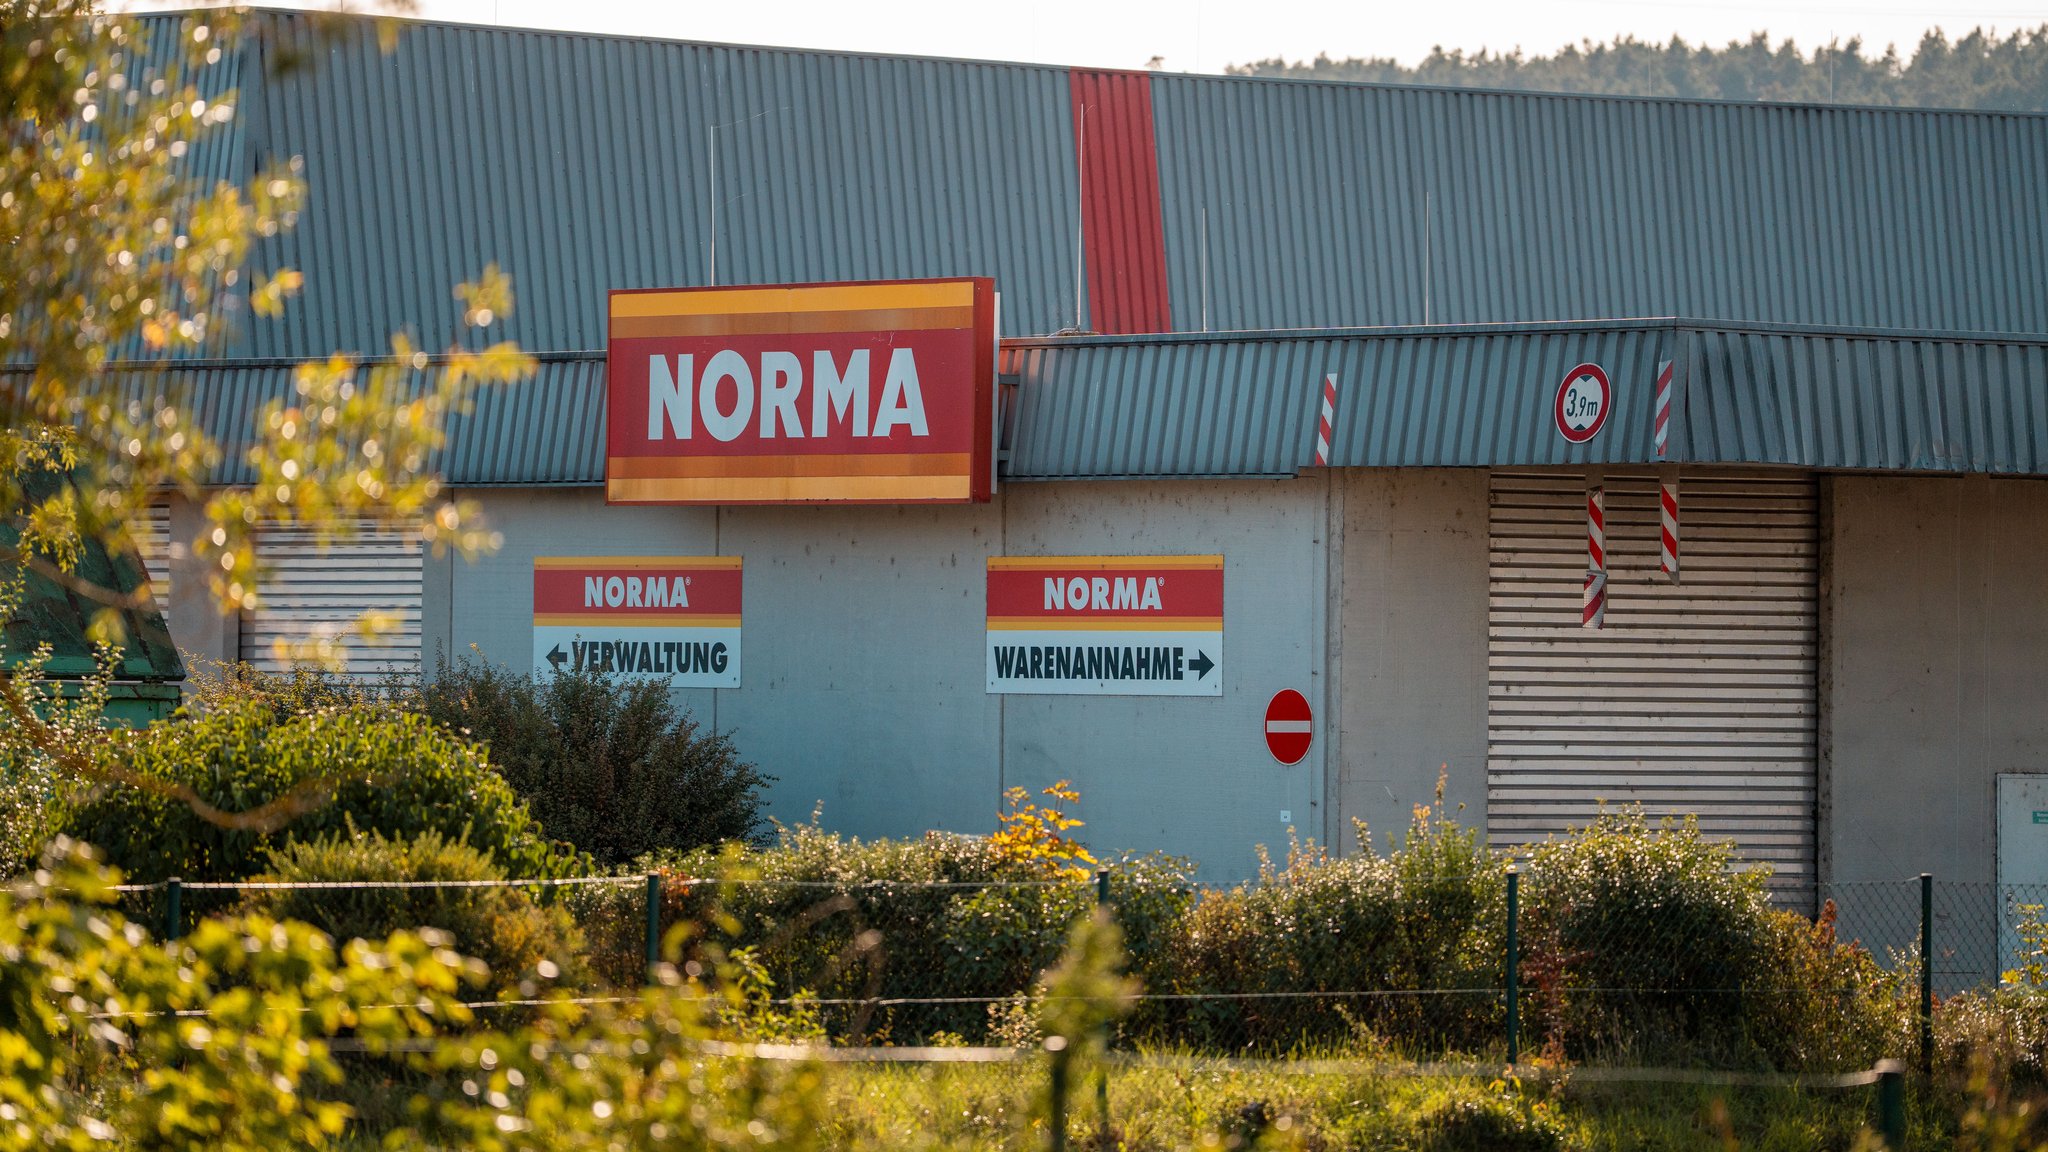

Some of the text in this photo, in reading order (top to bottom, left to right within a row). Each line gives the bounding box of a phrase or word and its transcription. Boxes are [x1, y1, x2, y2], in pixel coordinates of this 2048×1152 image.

[648, 347, 929, 442] NORMA
[1566, 388, 1598, 418] 3,9m
[571, 641, 728, 674] VERWALTUNG
[994, 646, 1184, 681] WARENANNAHME
